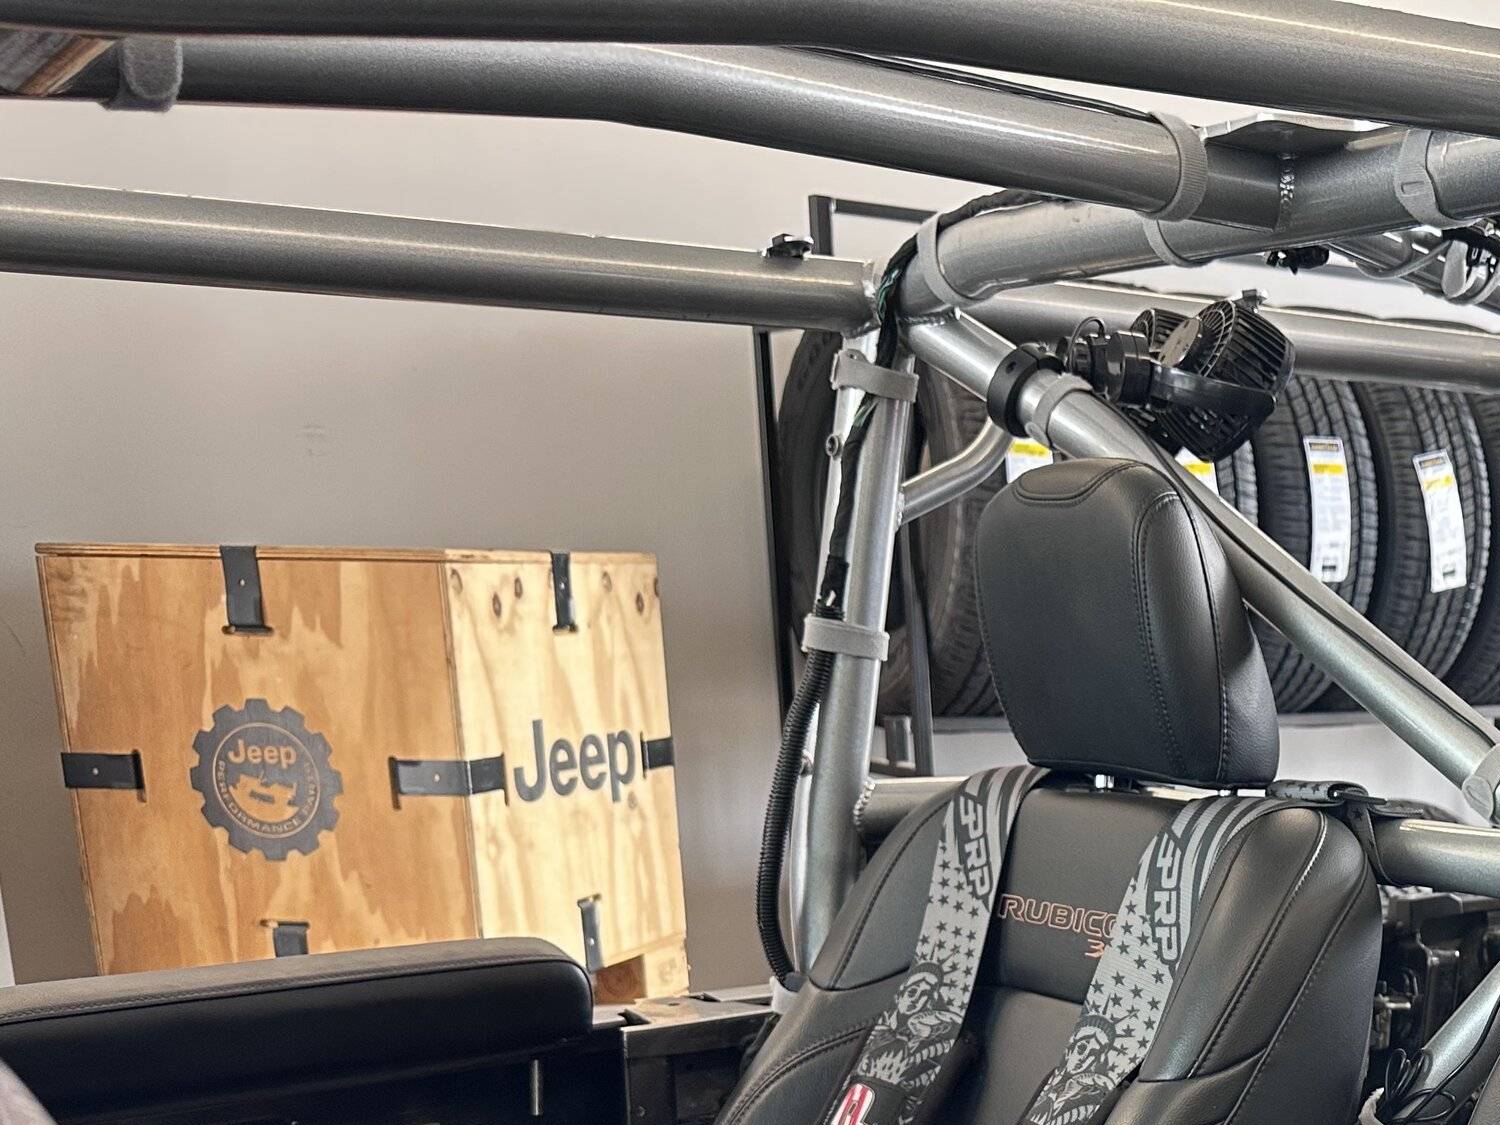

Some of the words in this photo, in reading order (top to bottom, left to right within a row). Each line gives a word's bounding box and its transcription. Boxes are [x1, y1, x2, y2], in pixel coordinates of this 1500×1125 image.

[227, 738, 298, 769] Jeep
[513, 719, 636, 803] Jeep
[216, 760, 302, 834] PERFORMANCE
[999, 893, 1119, 939] RUBICO
